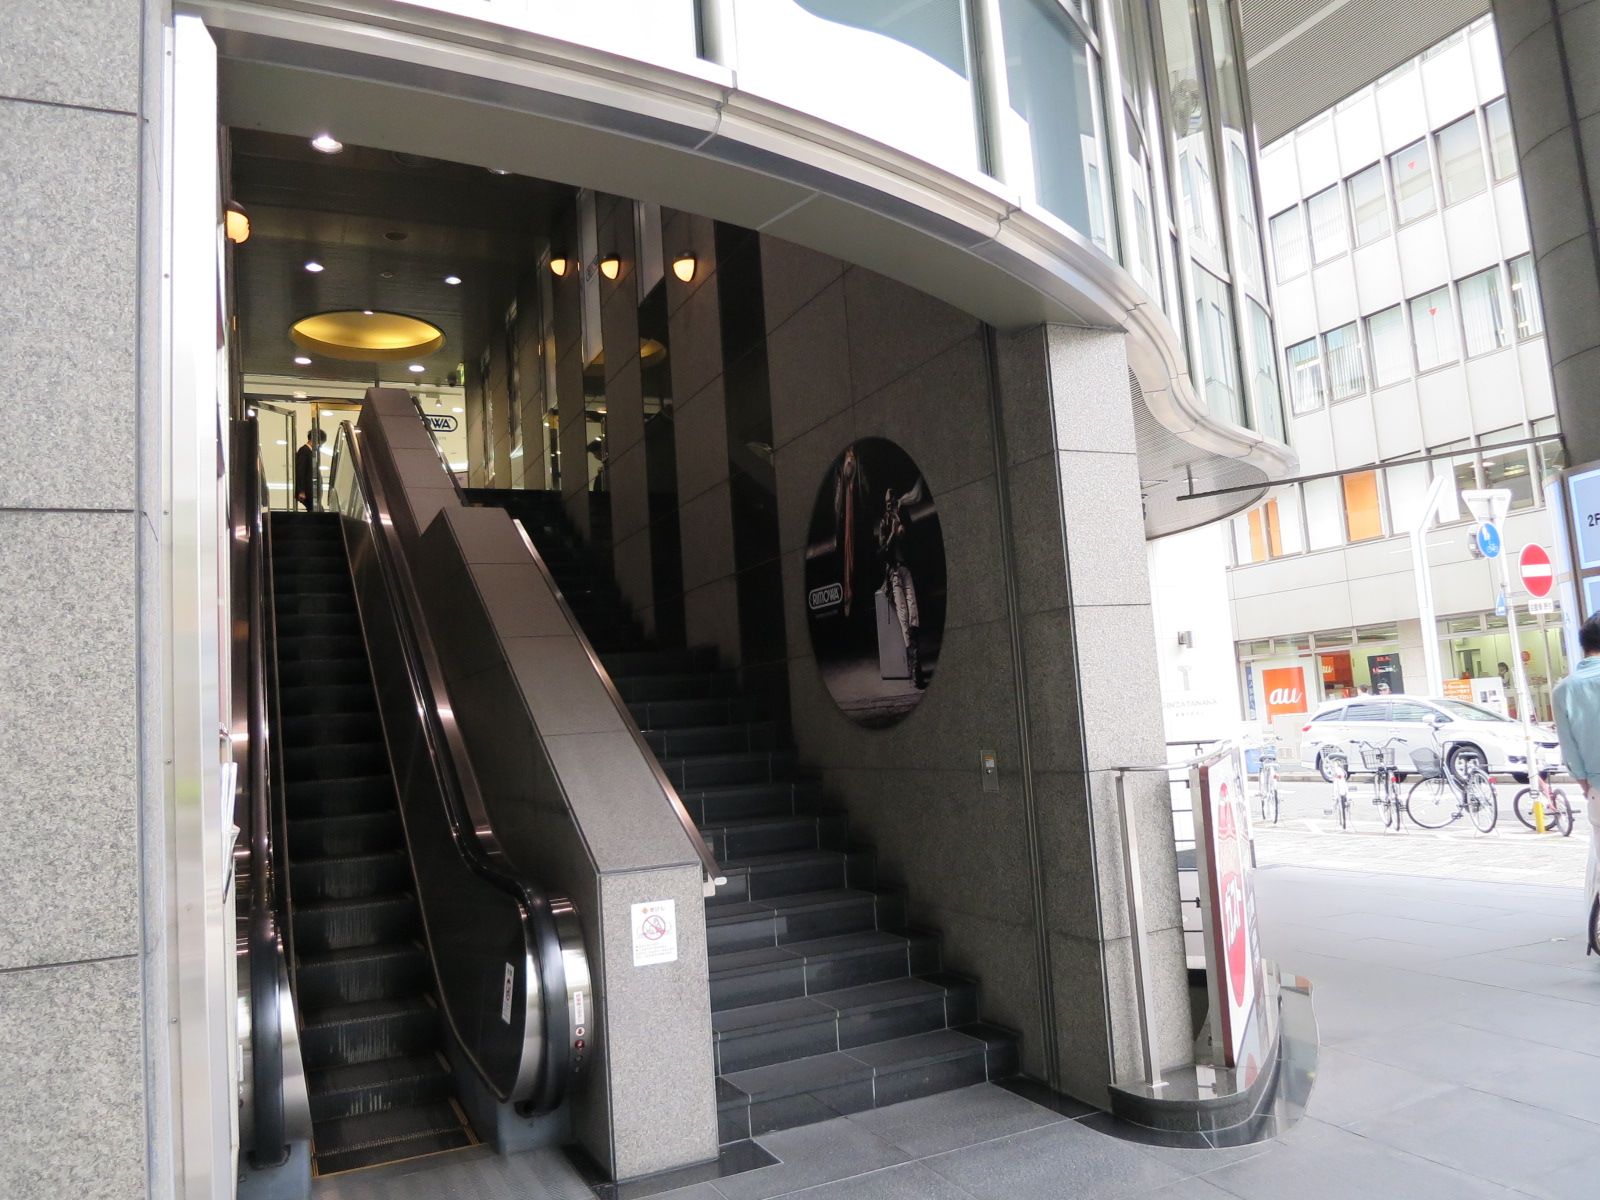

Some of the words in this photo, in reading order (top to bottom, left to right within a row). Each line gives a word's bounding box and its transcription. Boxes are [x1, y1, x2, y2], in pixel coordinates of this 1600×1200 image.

[1587, 512, 1600, 527] 2F
[811, 586, 840, 606] RIMOWA
[1269, 687, 1303, 705] au
